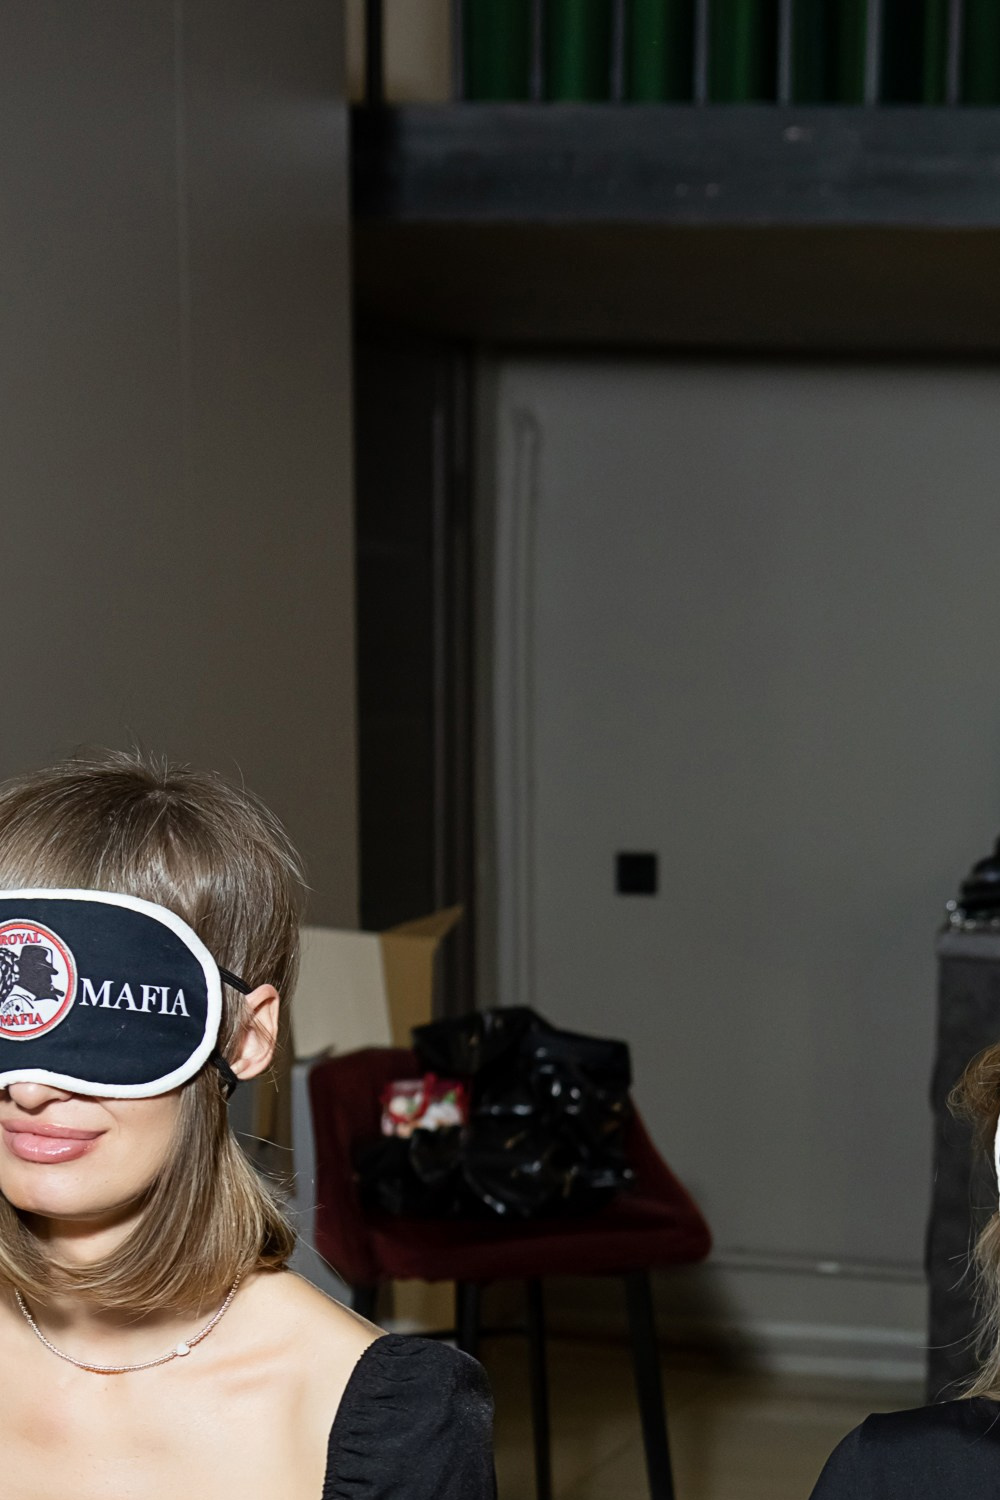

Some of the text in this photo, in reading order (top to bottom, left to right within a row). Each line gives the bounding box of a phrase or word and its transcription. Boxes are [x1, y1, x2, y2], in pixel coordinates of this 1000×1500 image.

[0, 932, 42, 945] ROYAL
[79, 977, 191, 1017] MAFIA
[0, 1013, 44, 1027] MAFIA
